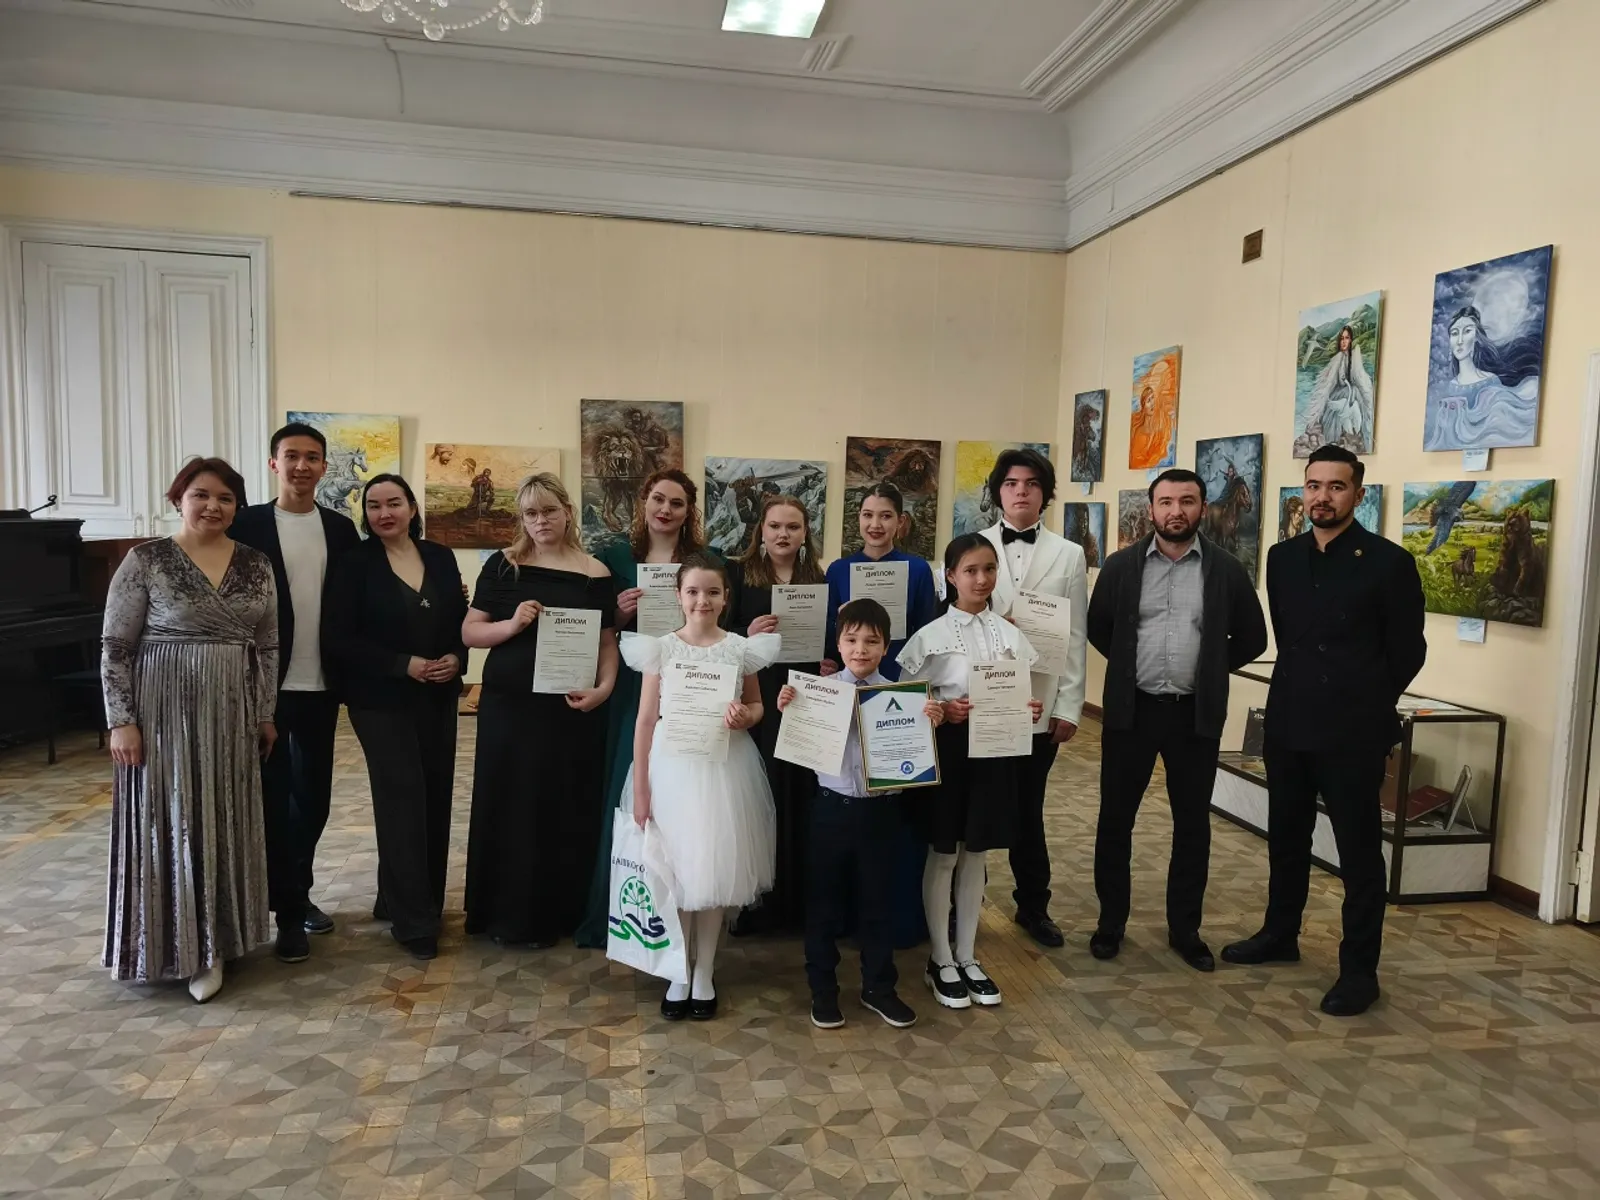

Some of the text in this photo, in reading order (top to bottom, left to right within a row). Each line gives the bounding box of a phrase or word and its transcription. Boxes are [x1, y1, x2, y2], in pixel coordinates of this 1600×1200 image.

[1028, 598, 1057, 609] ДИПЛОМ
[685, 671, 720, 680] ДИПЛОМ
[985, 671, 1016, 680] ДИПЛОМ
[804, 683, 840, 695] ДИПЛОМ
[876, 717, 915, 729] ДИПЛОМ
